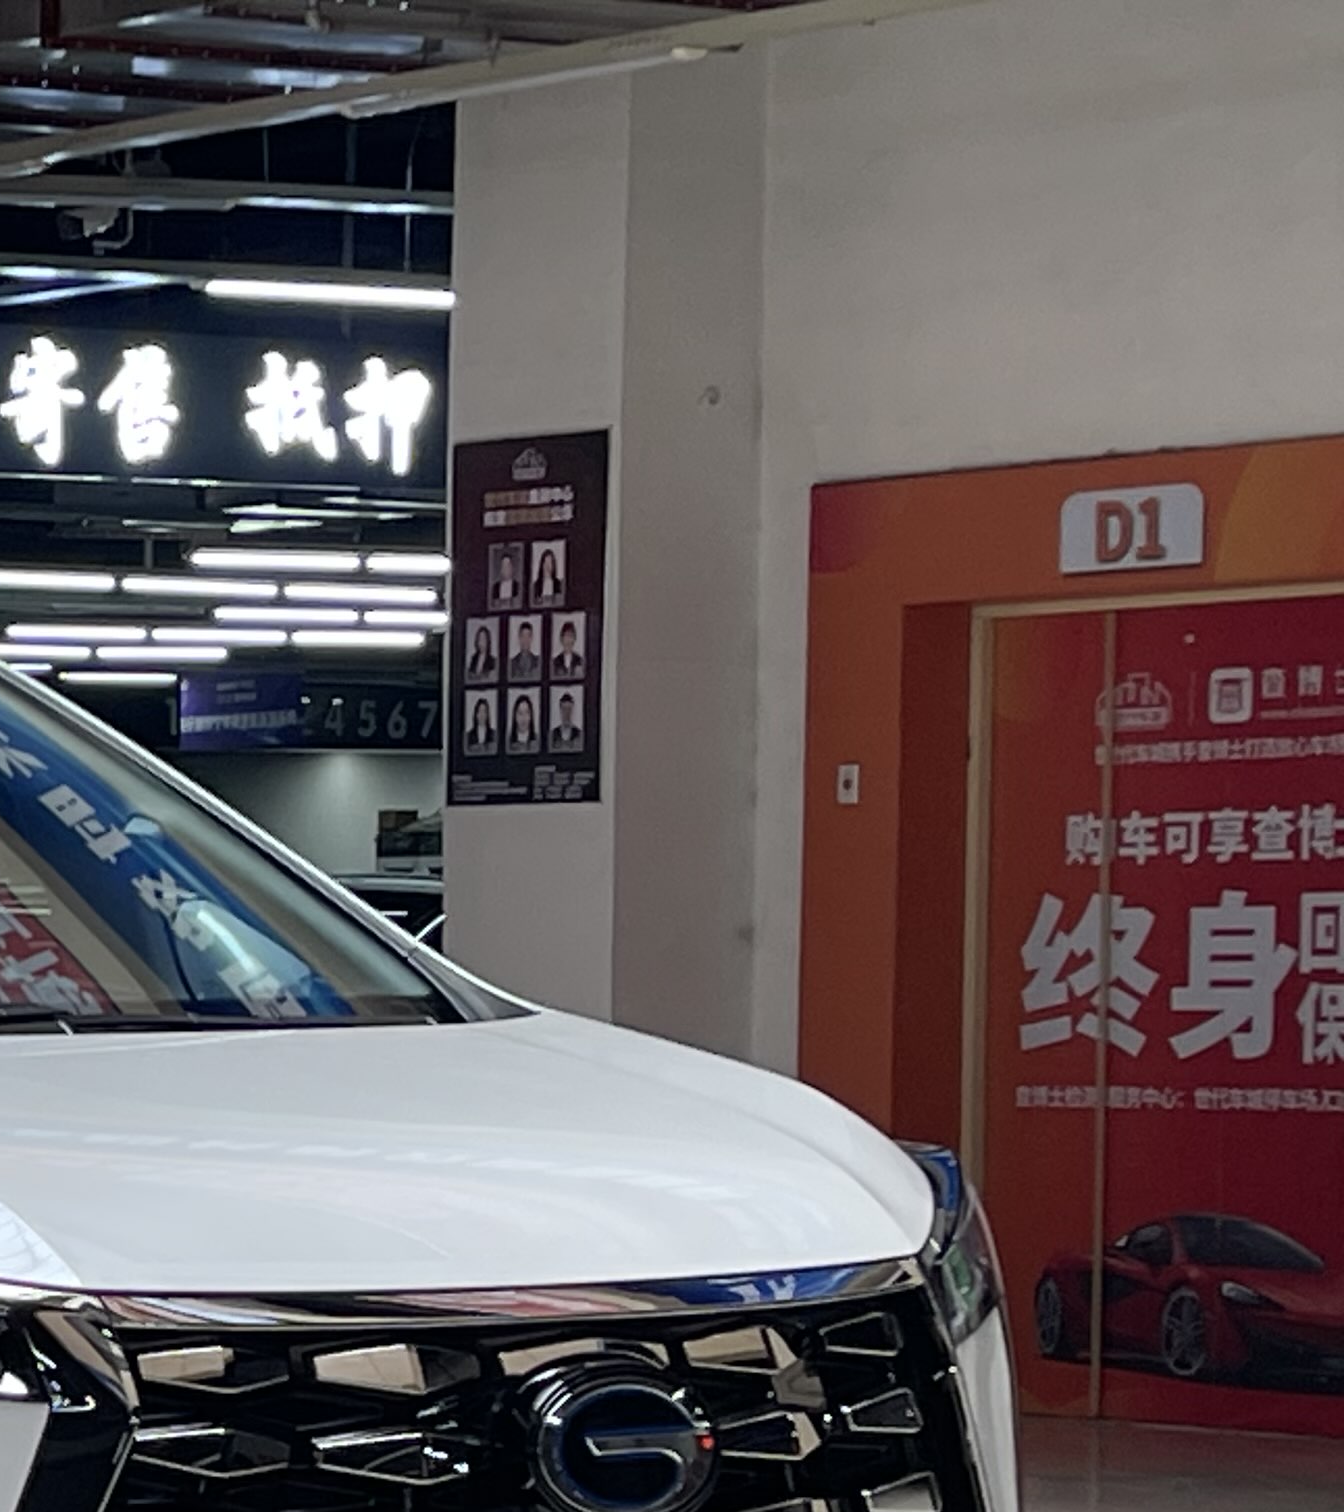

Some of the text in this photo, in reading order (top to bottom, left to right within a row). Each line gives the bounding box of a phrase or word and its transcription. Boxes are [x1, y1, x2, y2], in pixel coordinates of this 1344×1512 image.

[0, 335, 179, 467] 寄售
[245, 350, 433, 476] 抵押
[1094, 496, 1167, 564] D1
[1020, 889, 1299, 1060] 终身
